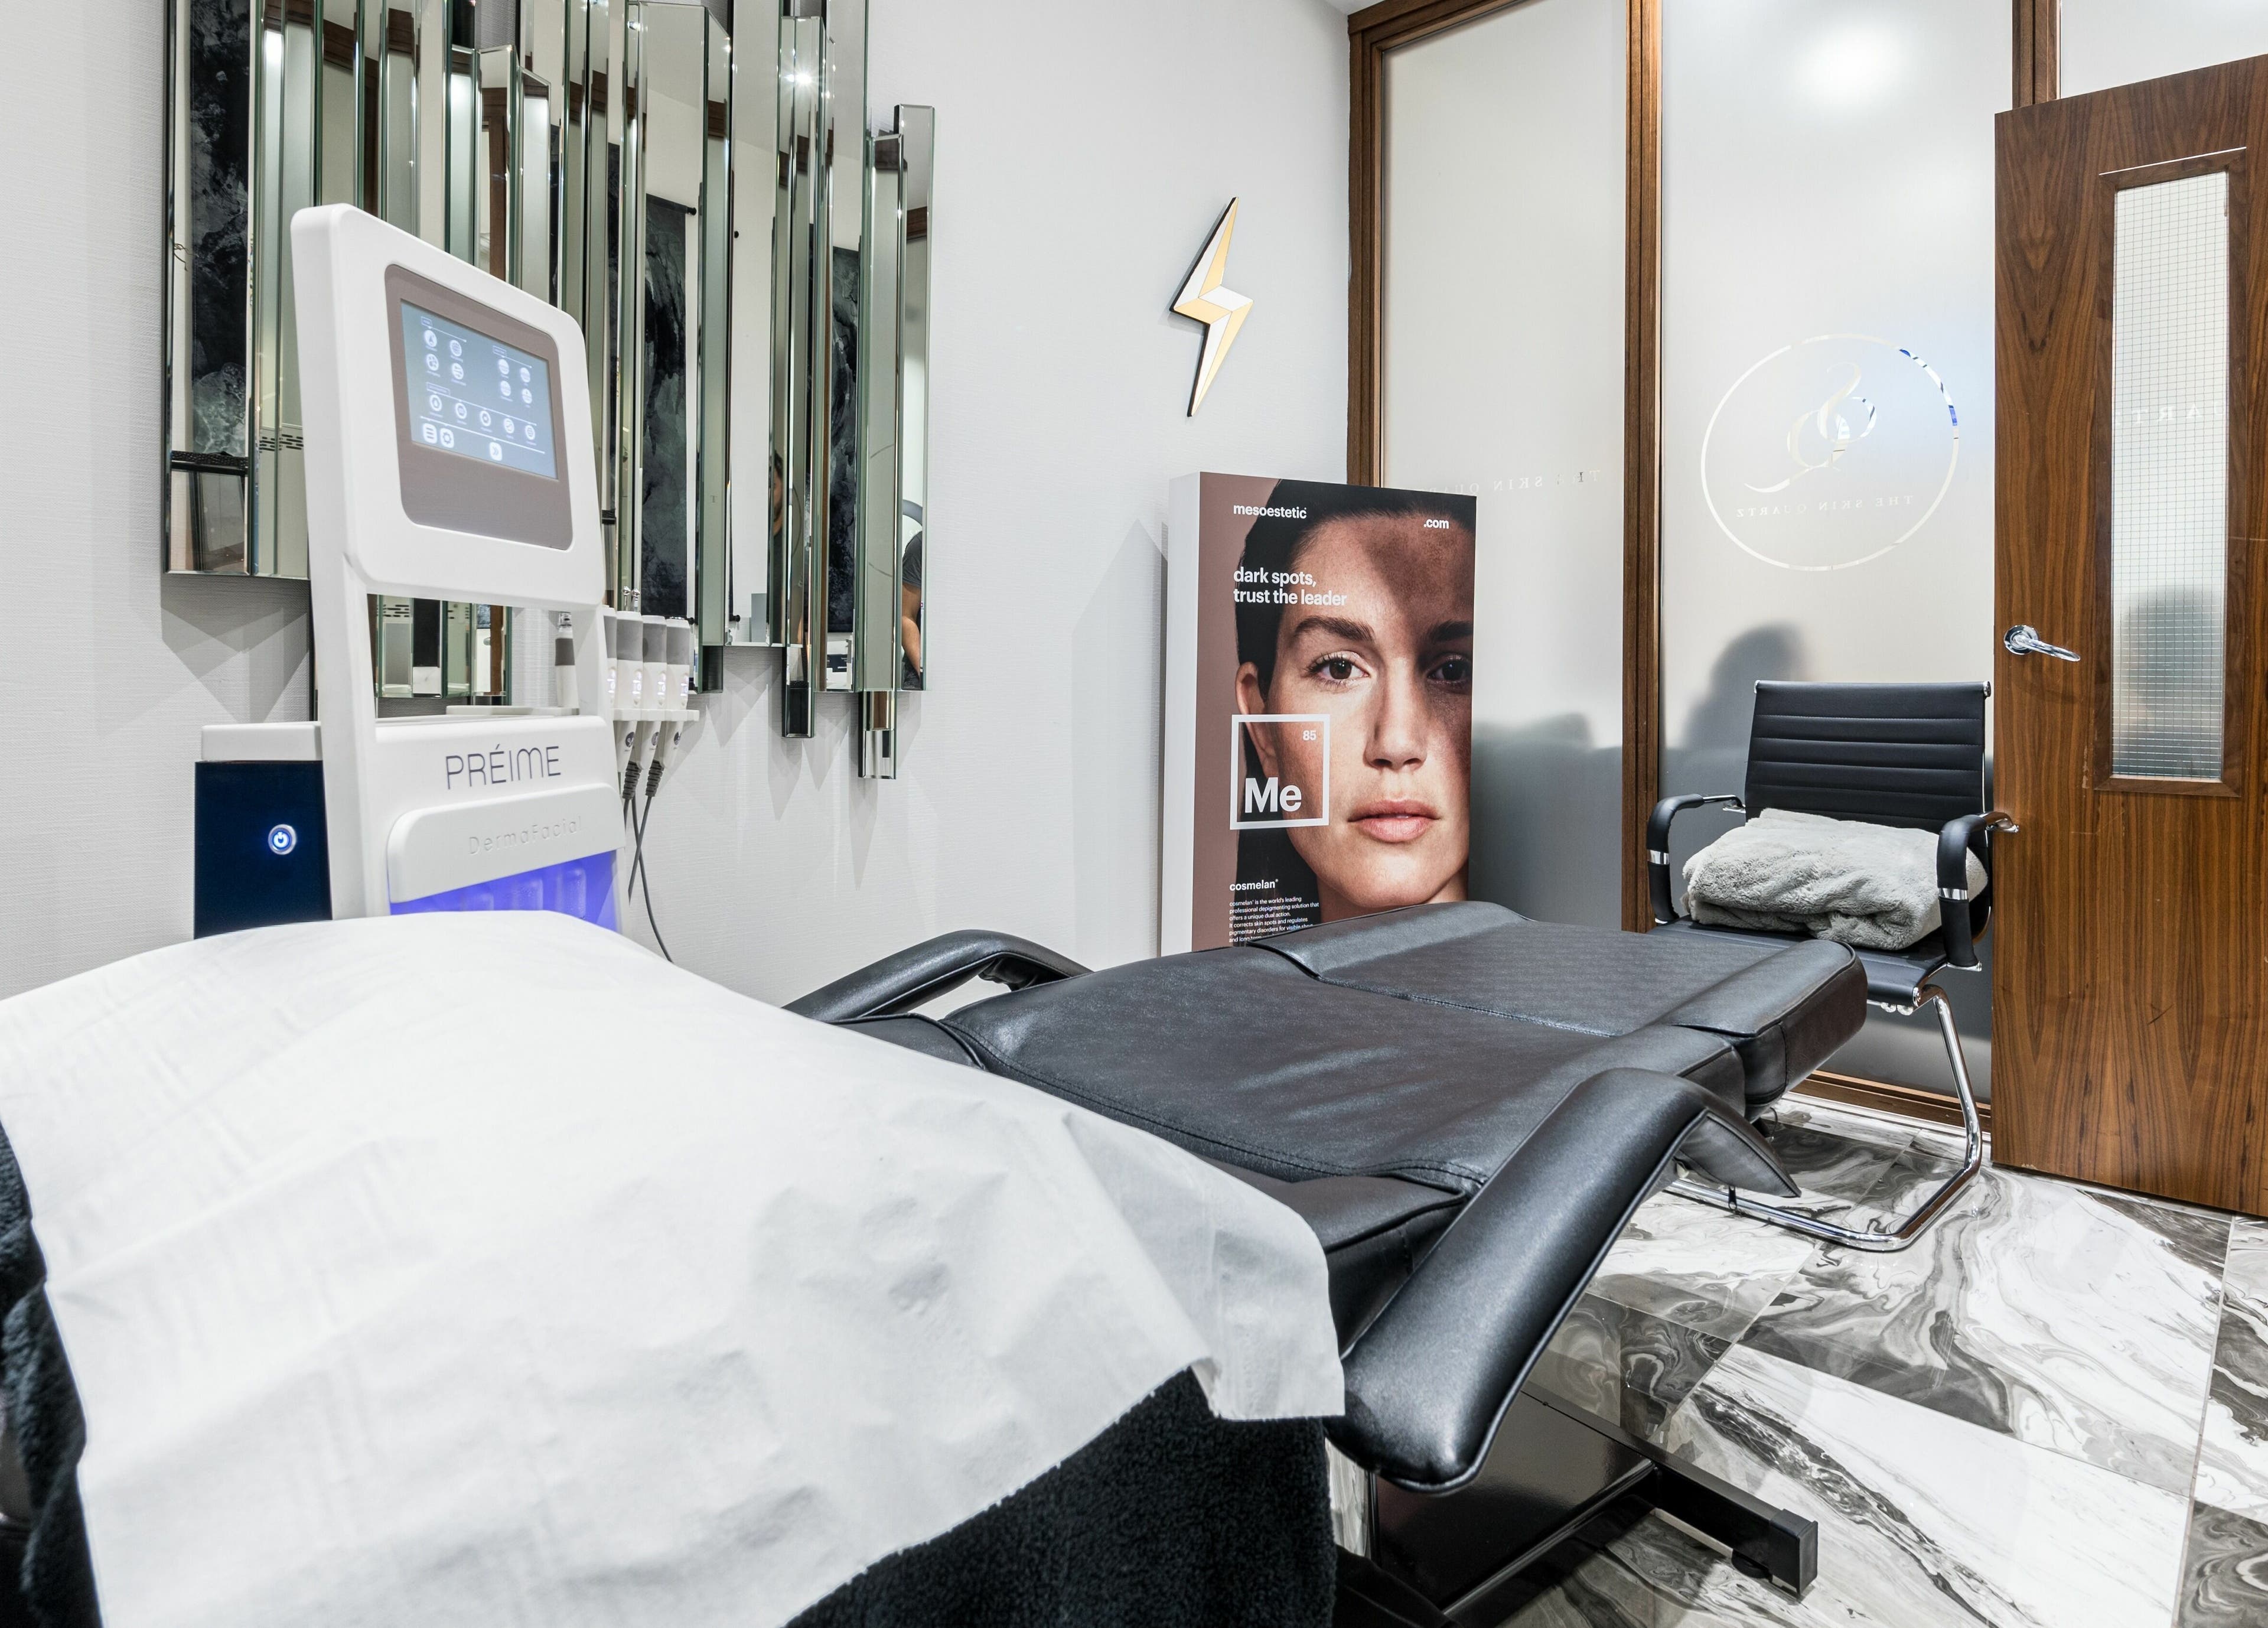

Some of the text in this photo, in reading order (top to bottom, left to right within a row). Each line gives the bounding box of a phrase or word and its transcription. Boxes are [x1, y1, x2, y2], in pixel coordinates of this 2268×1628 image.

[1423, 519, 1449, 529] .com
[1233, 566, 1317, 587] dark spots,
[1233, 588, 1347, 606] trust the leader
[1302, 730, 1317, 741] 85
[446, 744, 561, 790] PRÉIME
[1244, 777, 1302, 813] Me
[1229, 906, 1258, 914] professional
[1259, 904, 1291, 913] depigmenting
